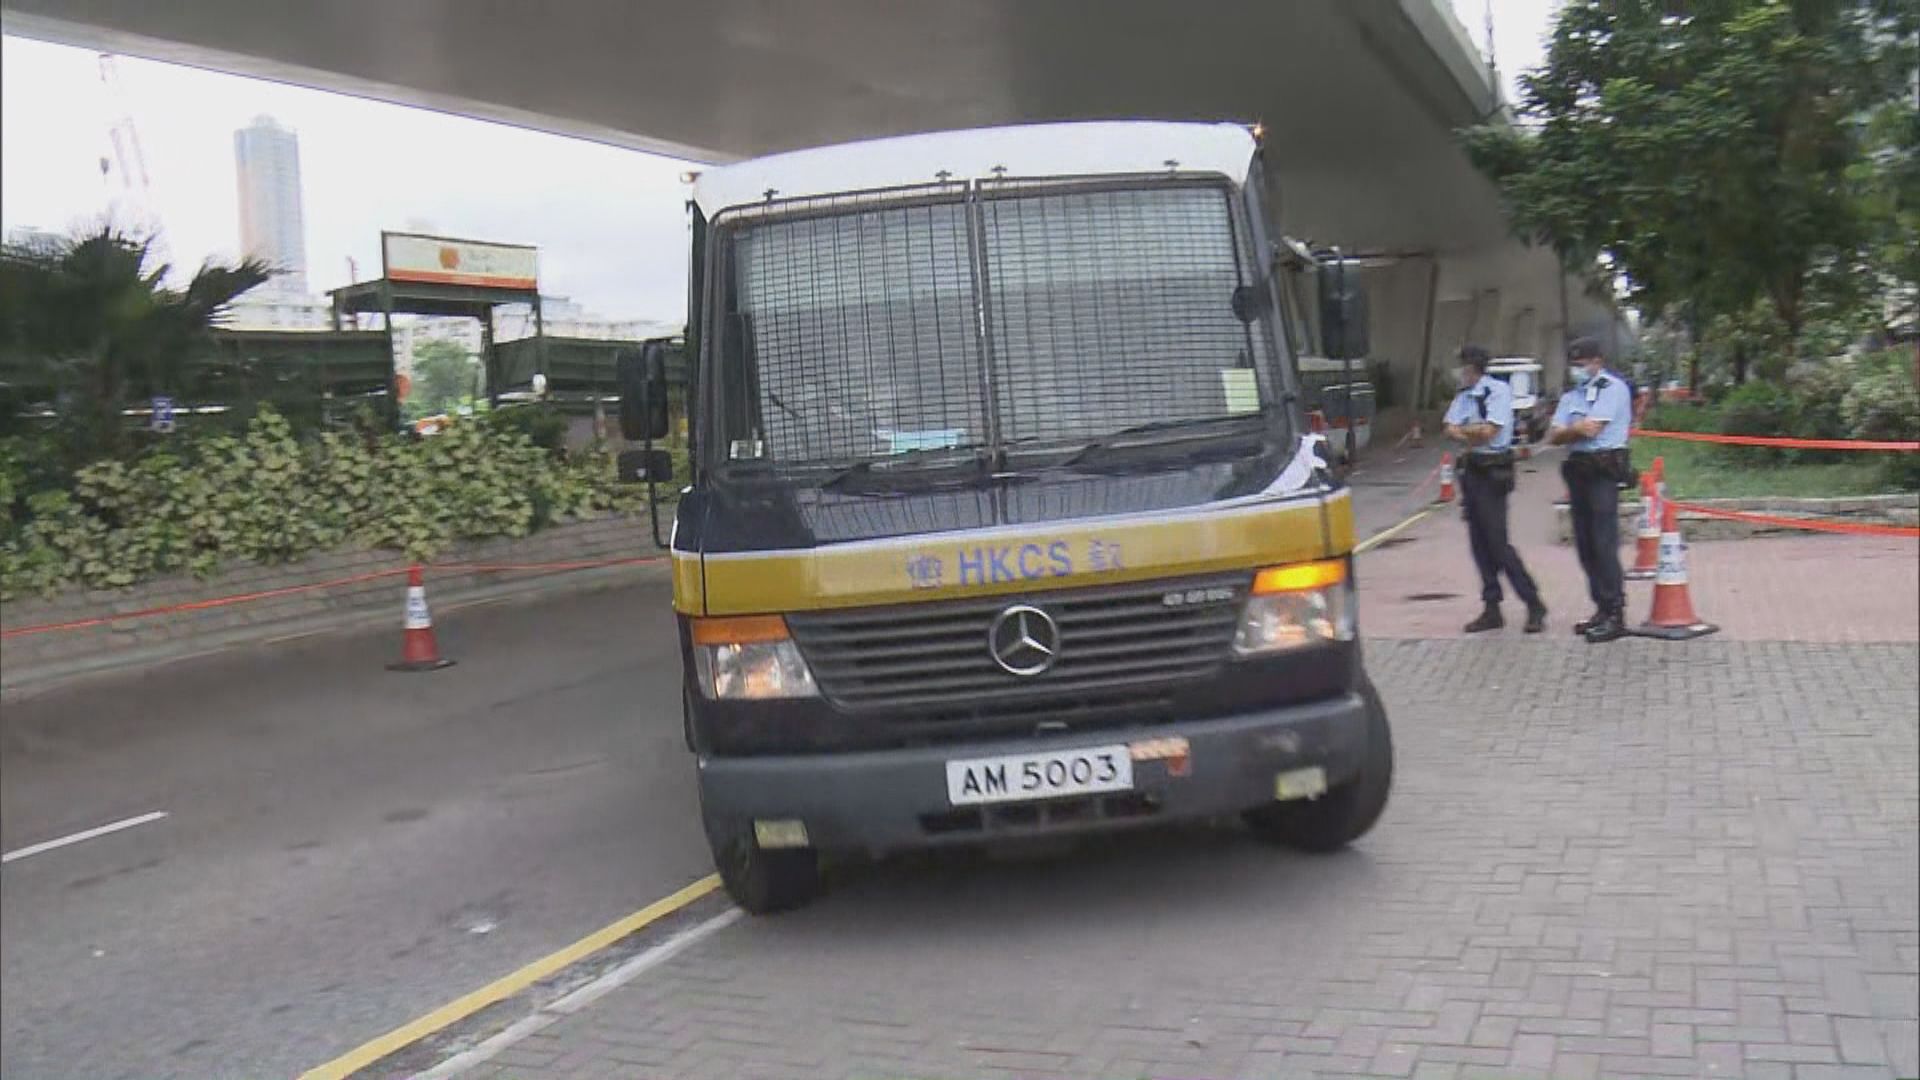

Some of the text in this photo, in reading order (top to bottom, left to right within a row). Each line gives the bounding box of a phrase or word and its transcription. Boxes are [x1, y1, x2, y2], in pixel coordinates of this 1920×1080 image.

[958, 540, 1073, 587] HKCS
[962, 754, 1117, 796] AM 5003
